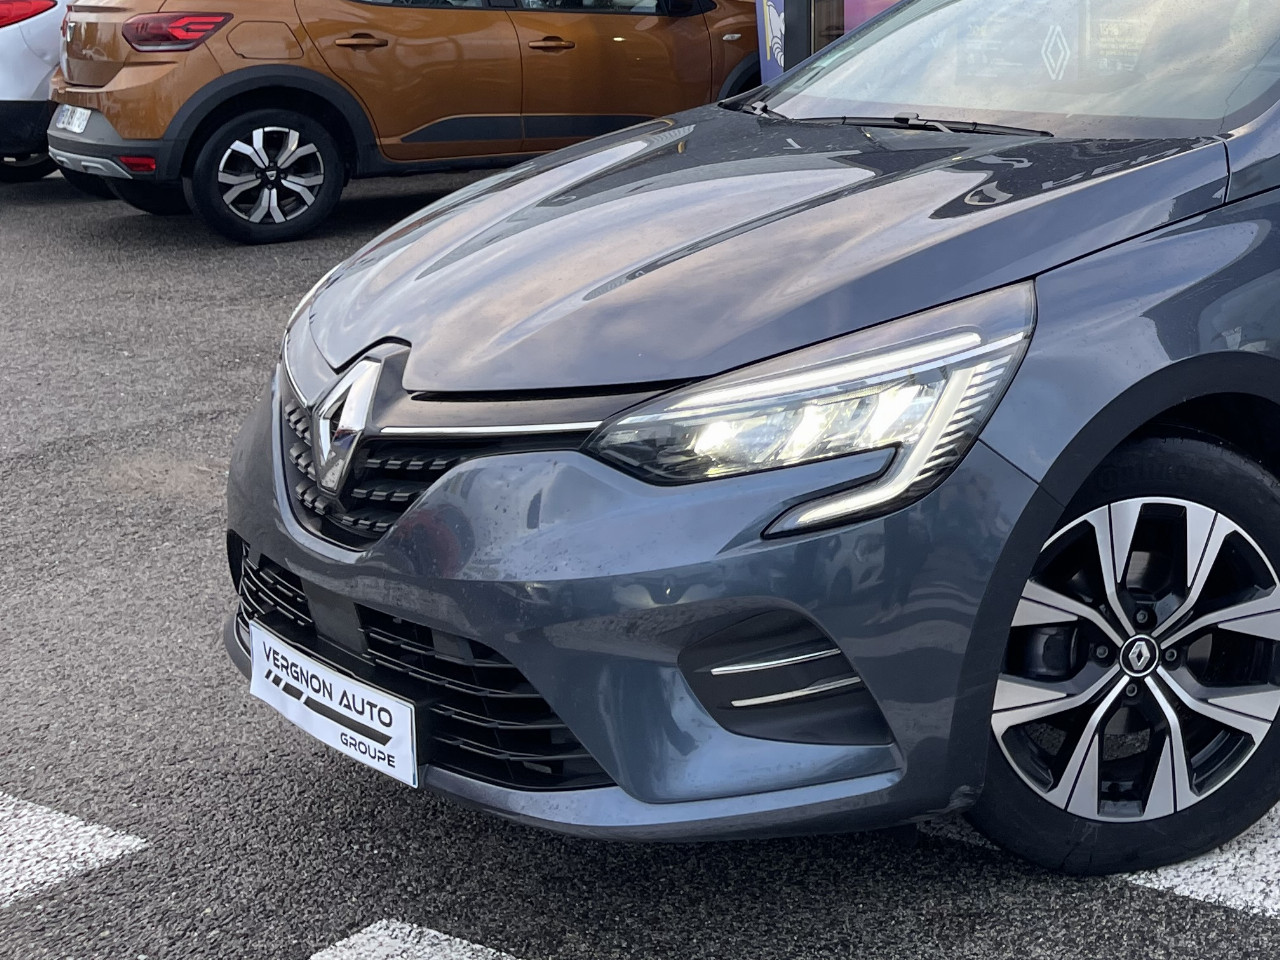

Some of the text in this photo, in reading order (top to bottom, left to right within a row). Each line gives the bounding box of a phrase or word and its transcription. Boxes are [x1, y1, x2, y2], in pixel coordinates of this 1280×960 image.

[263, 641, 393, 728] VERGNON AUTO
[340, 732, 396, 769] GROUPE
